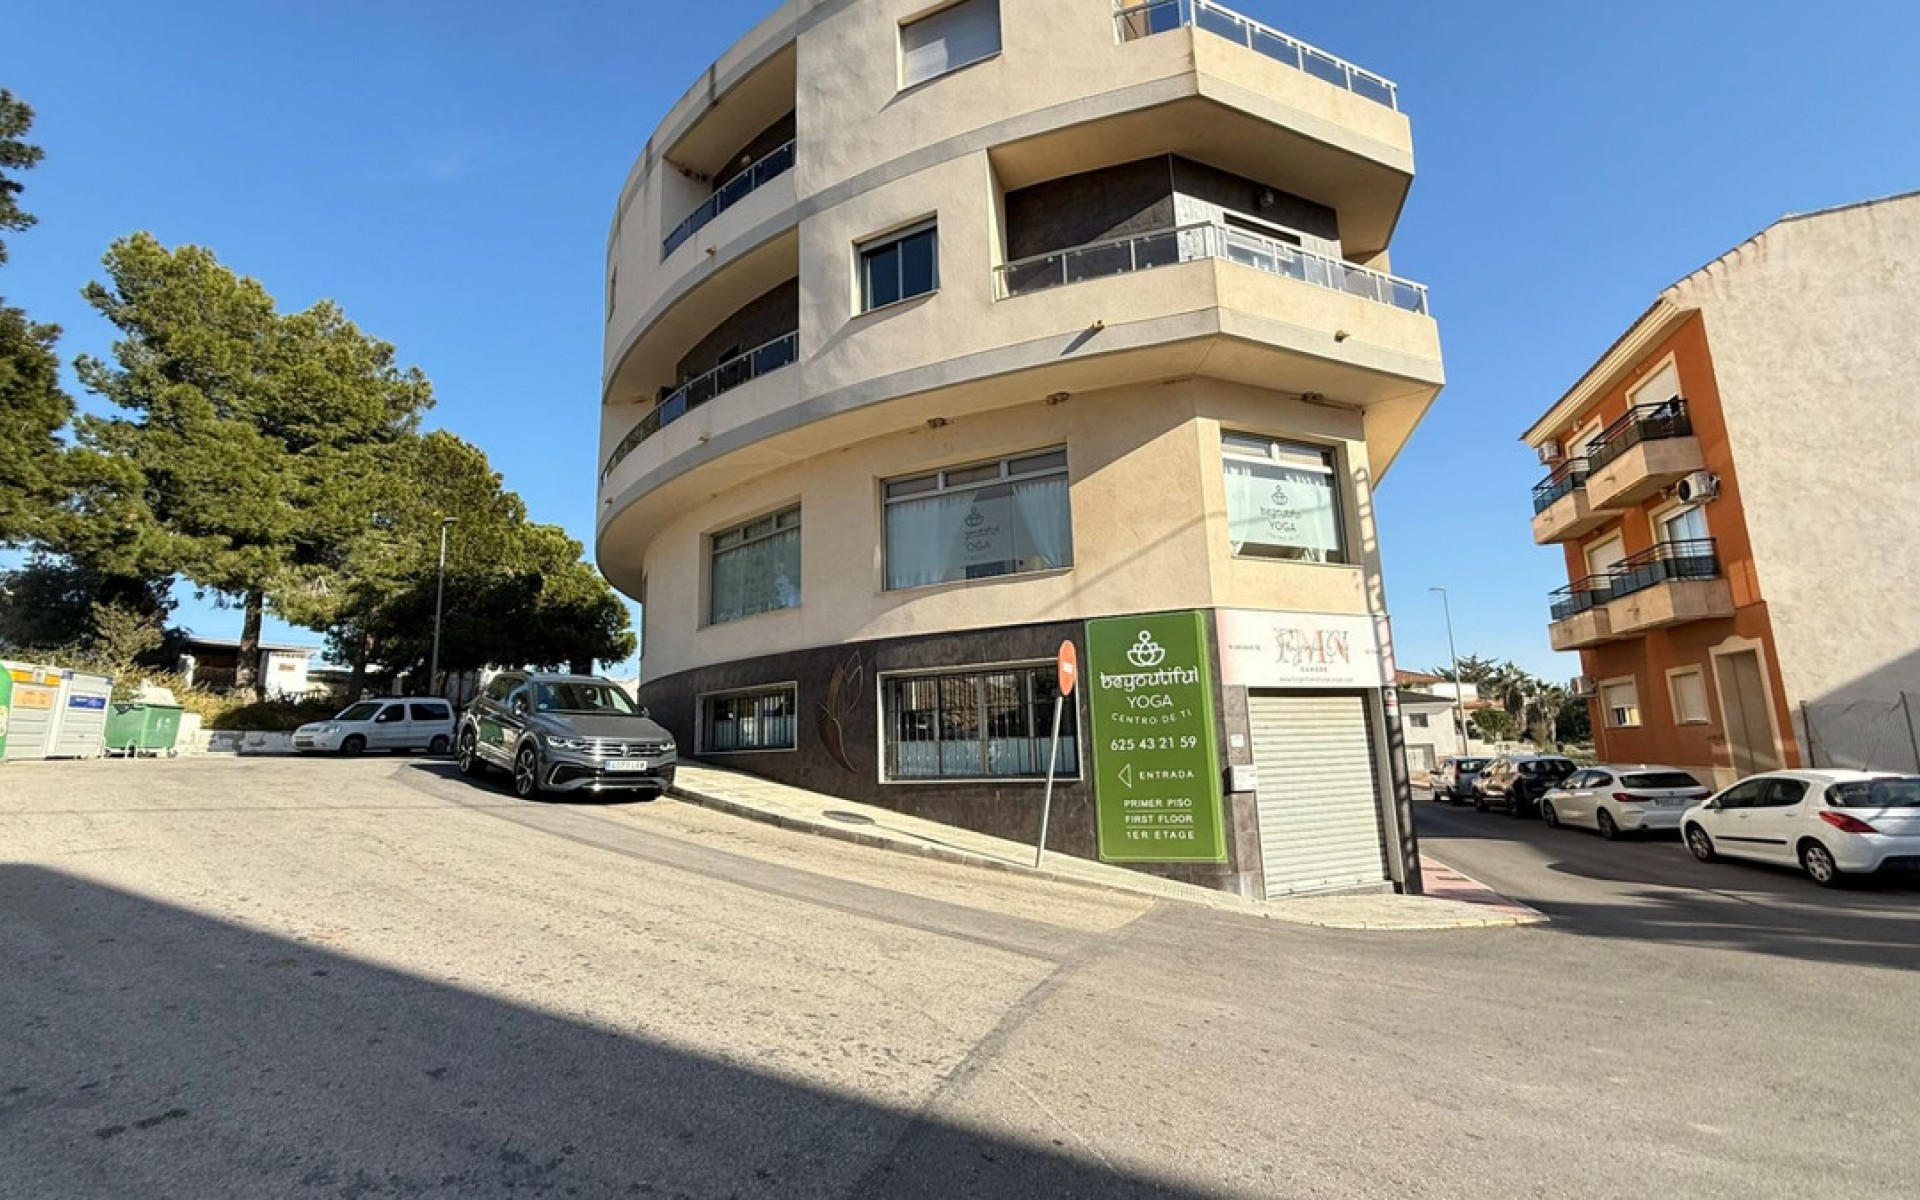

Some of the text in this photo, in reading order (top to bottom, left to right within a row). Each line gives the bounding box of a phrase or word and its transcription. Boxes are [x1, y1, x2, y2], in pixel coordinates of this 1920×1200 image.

[1100, 666, 1199, 692] beyoutiful
[1126, 694, 1174, 709] YOGA
[1111, 712, 1157, 725] CENTRO
[1161, 713, 1177, 723] DE
[1110, 735, 1197, 751] 625 43 21 59
[1139, 770, 1194, 780] ENTRADA
[1123, 798, 1193, 808] PRIMER PISO
[1125, 814, 1194, 824] FIRST FLOOR
[1126, 830, 1195, 840] 1ER ETAGE
